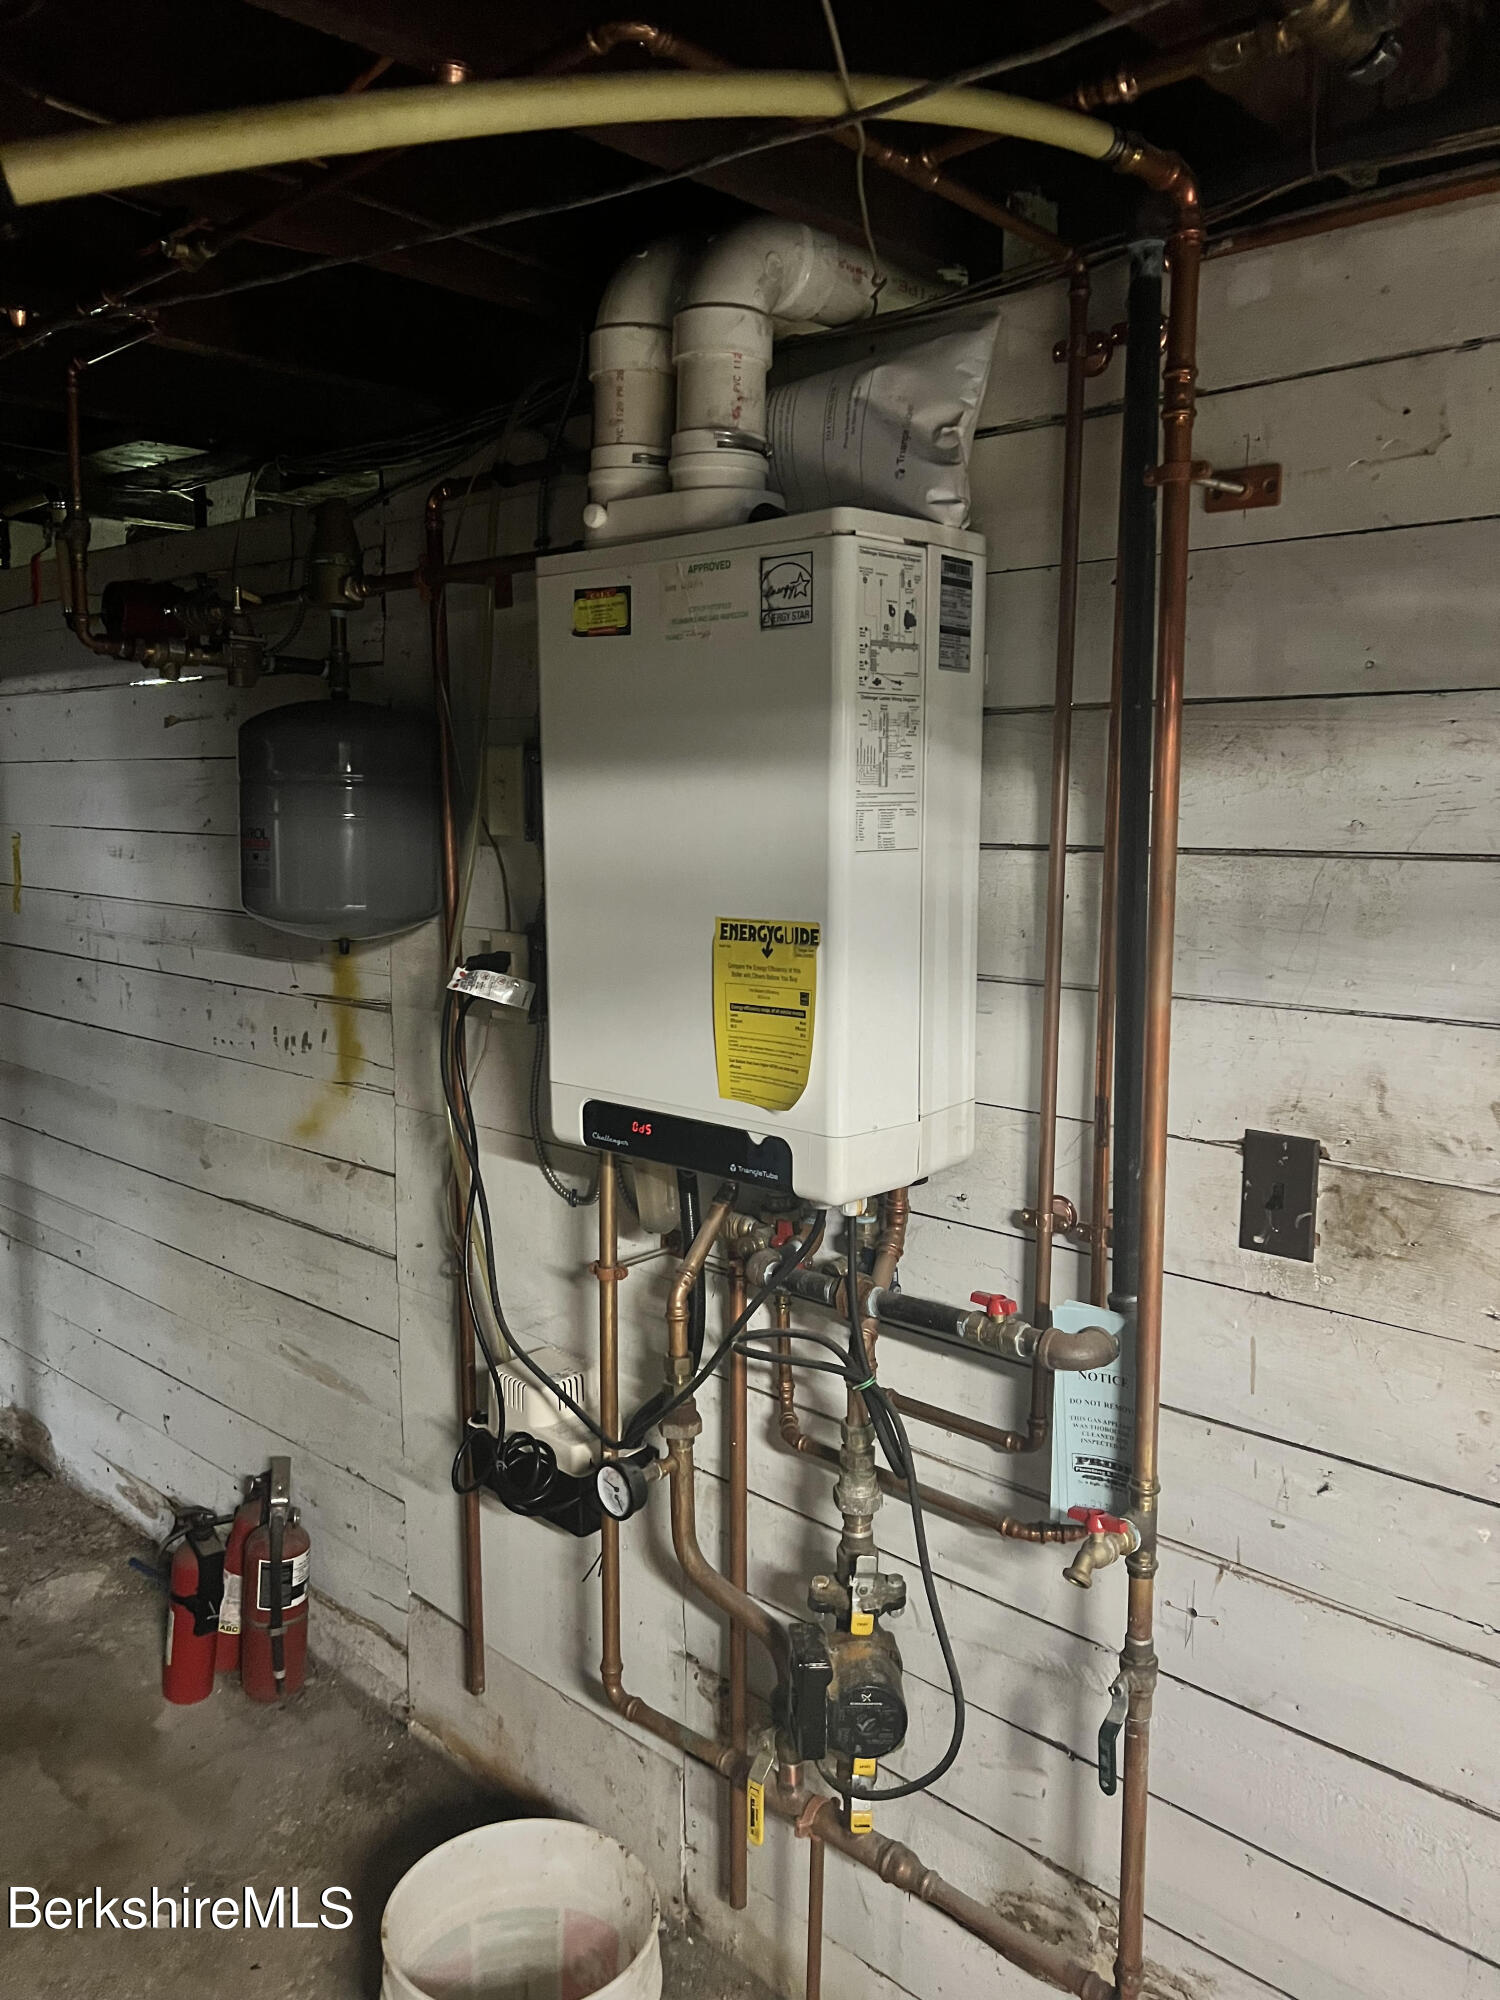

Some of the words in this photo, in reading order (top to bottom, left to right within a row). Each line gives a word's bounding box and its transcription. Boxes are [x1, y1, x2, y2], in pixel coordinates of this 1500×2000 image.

[688, 560, 731, 574] APPROVED
[764, 611, 790, 626] ENERGY
[792, 610, 810, 621] STAR
[591, 1131, 629, 1147] Challenger
[1078, 1370, 1129, 1389] NOTICE
[1069, 1397, 1083, 1406] DO
[1083, 1398, 1101, 1408] NOT
[1088, 1416, 1102, 1424] GAS
[1080, 1438, 1117, 1449] INSPECTED
[219, 1624, 238, 1634] ABC
